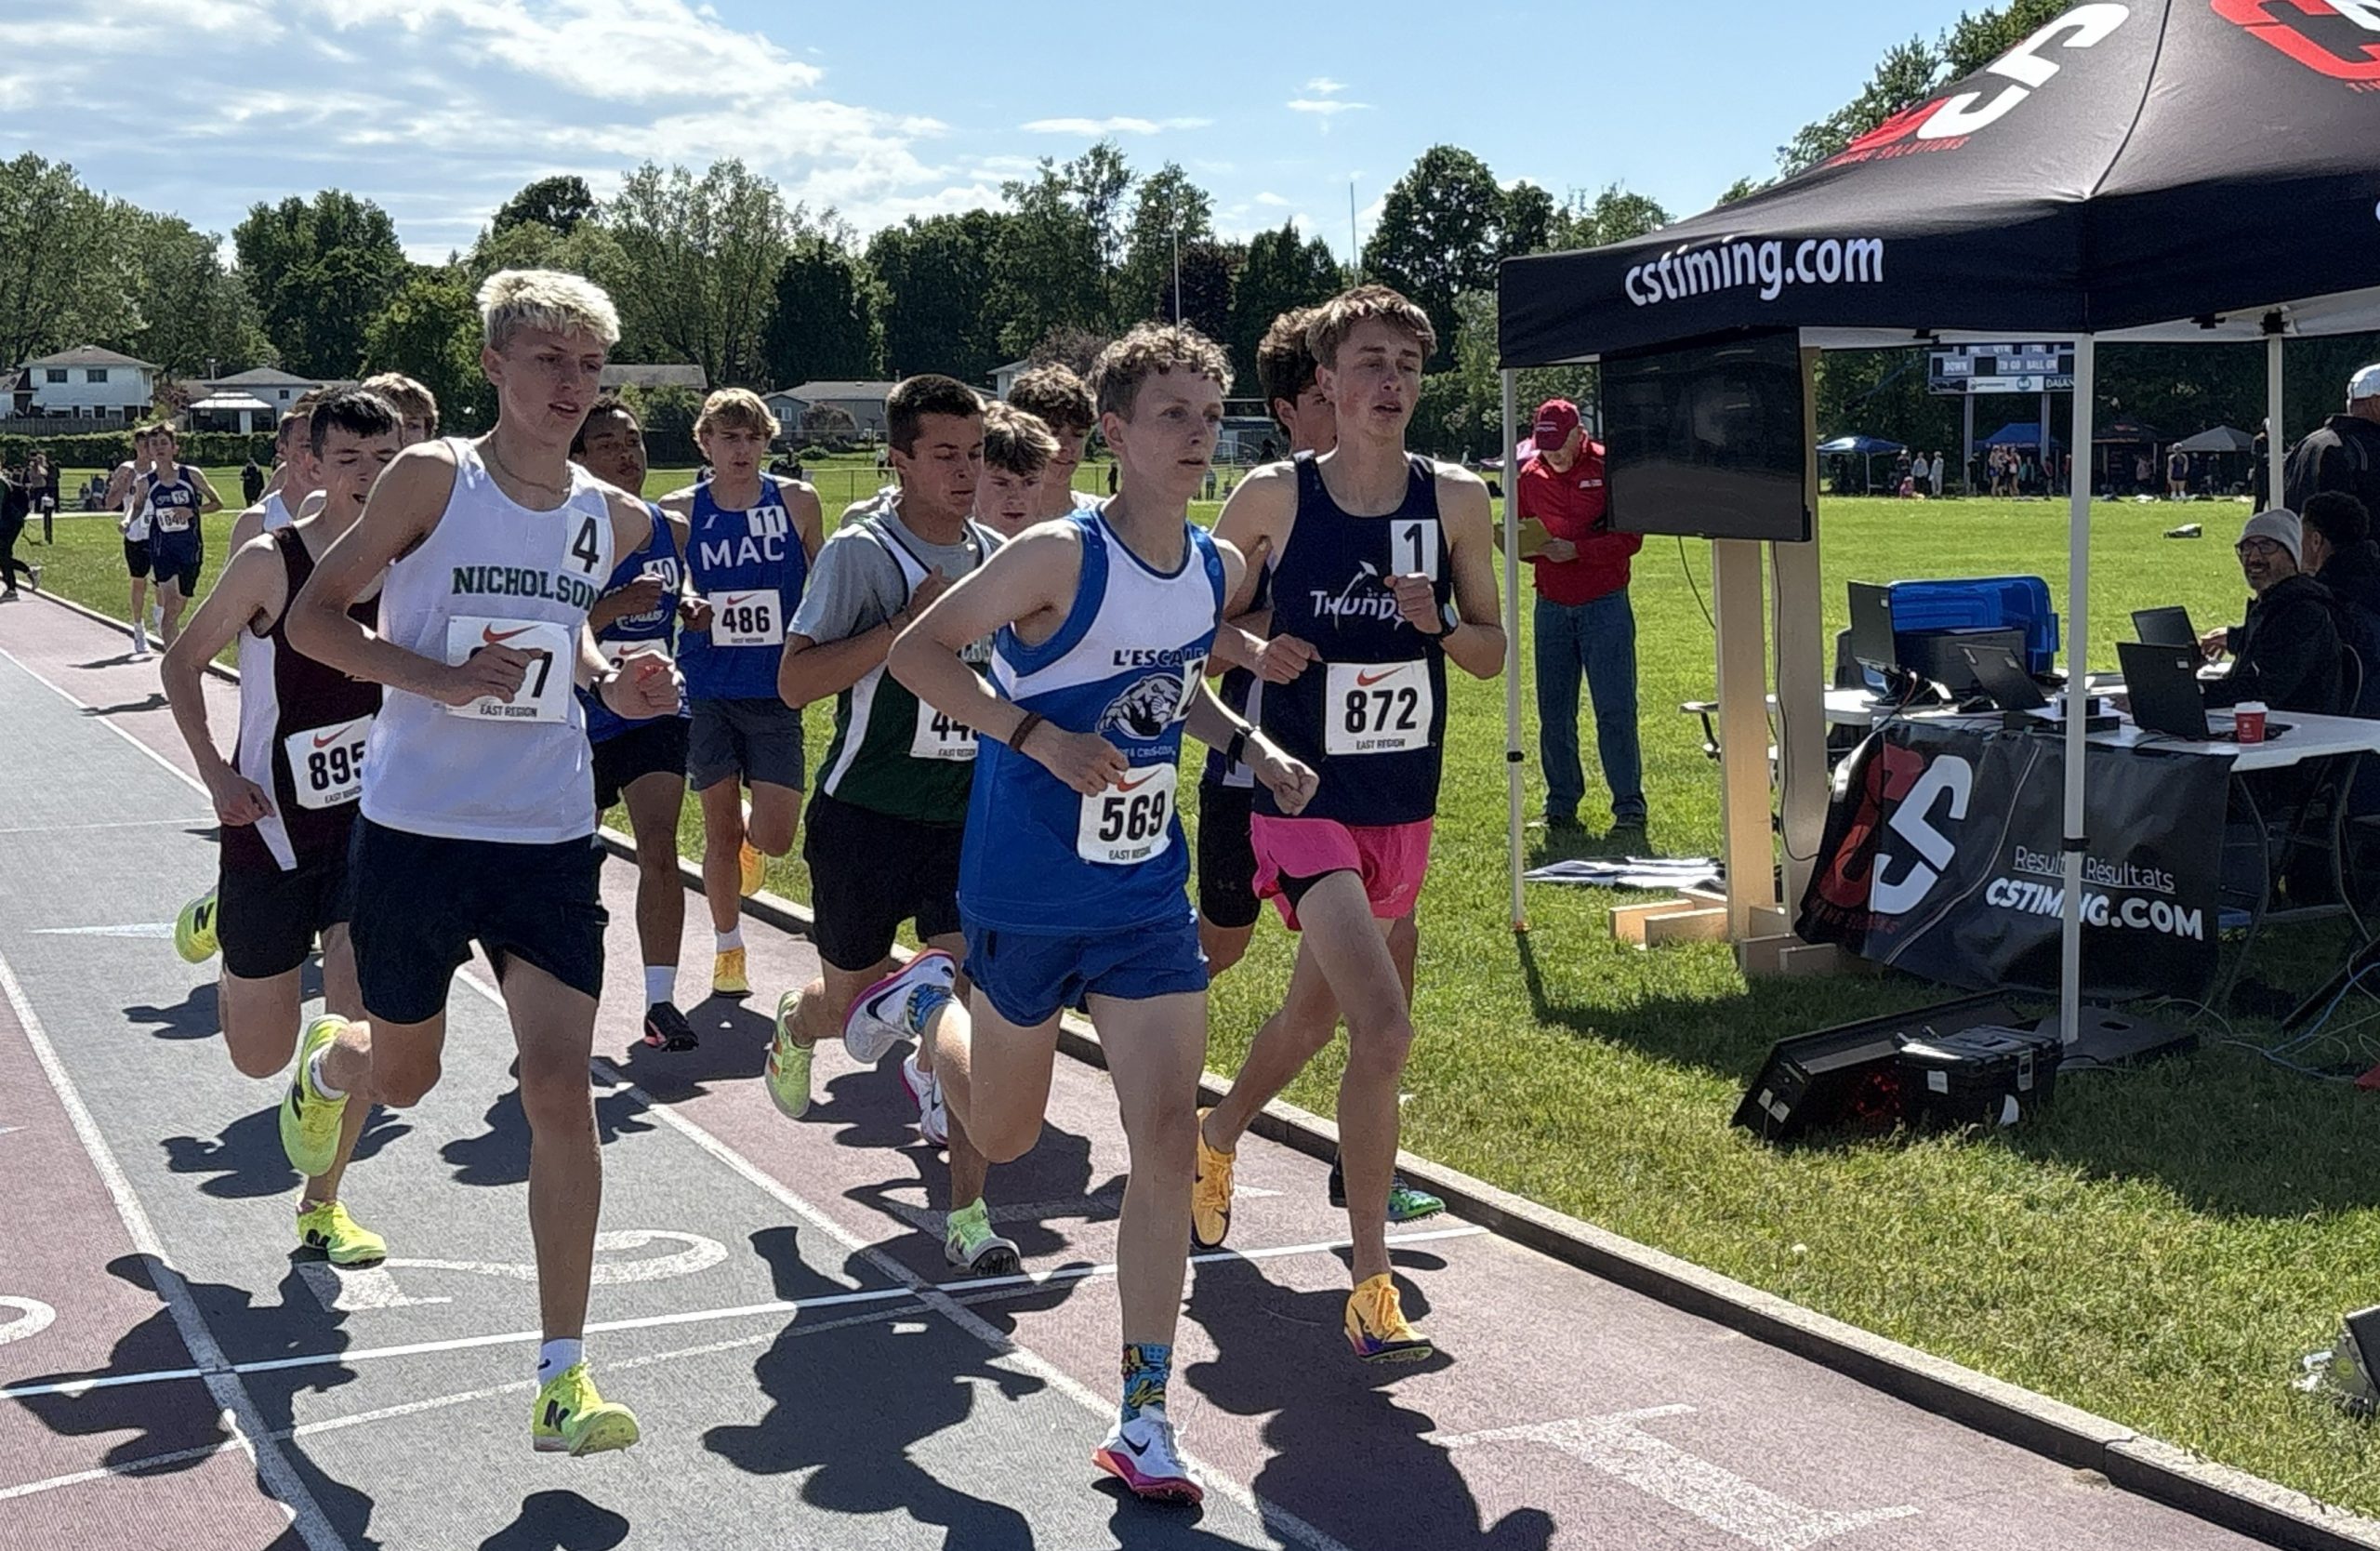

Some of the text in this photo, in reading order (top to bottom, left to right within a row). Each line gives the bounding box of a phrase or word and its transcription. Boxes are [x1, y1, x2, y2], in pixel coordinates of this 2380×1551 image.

[1625, 234, 1884, 306] cstiming.com
[1944, 362, 1967, 372] DOWN
[755, 509, 780, 533] 11
[572, 516, 600, 573] 4
[700, 532, 787, 571] MAC
[1404, 524, 1422, 573] 1
[452, 565, 600, 610] NICHOLSON
[721, 606, 771, 633] 486
[481, 704, 537, 717] EAST REGION
[931, 710, 980, 741] 44
[1345, 687, 1418, 734] 872
[1355, 738, 1406, 750] EAST REGION
[1099, 789, 1166, 842] 569
[1109, 849, 1130, 860] EAST
[2015, 845, 2066, 874] Result
[2086, 857, 2175, 891] Résultats
[1986, 877, 2204, 941] CSTIMNG.COM
